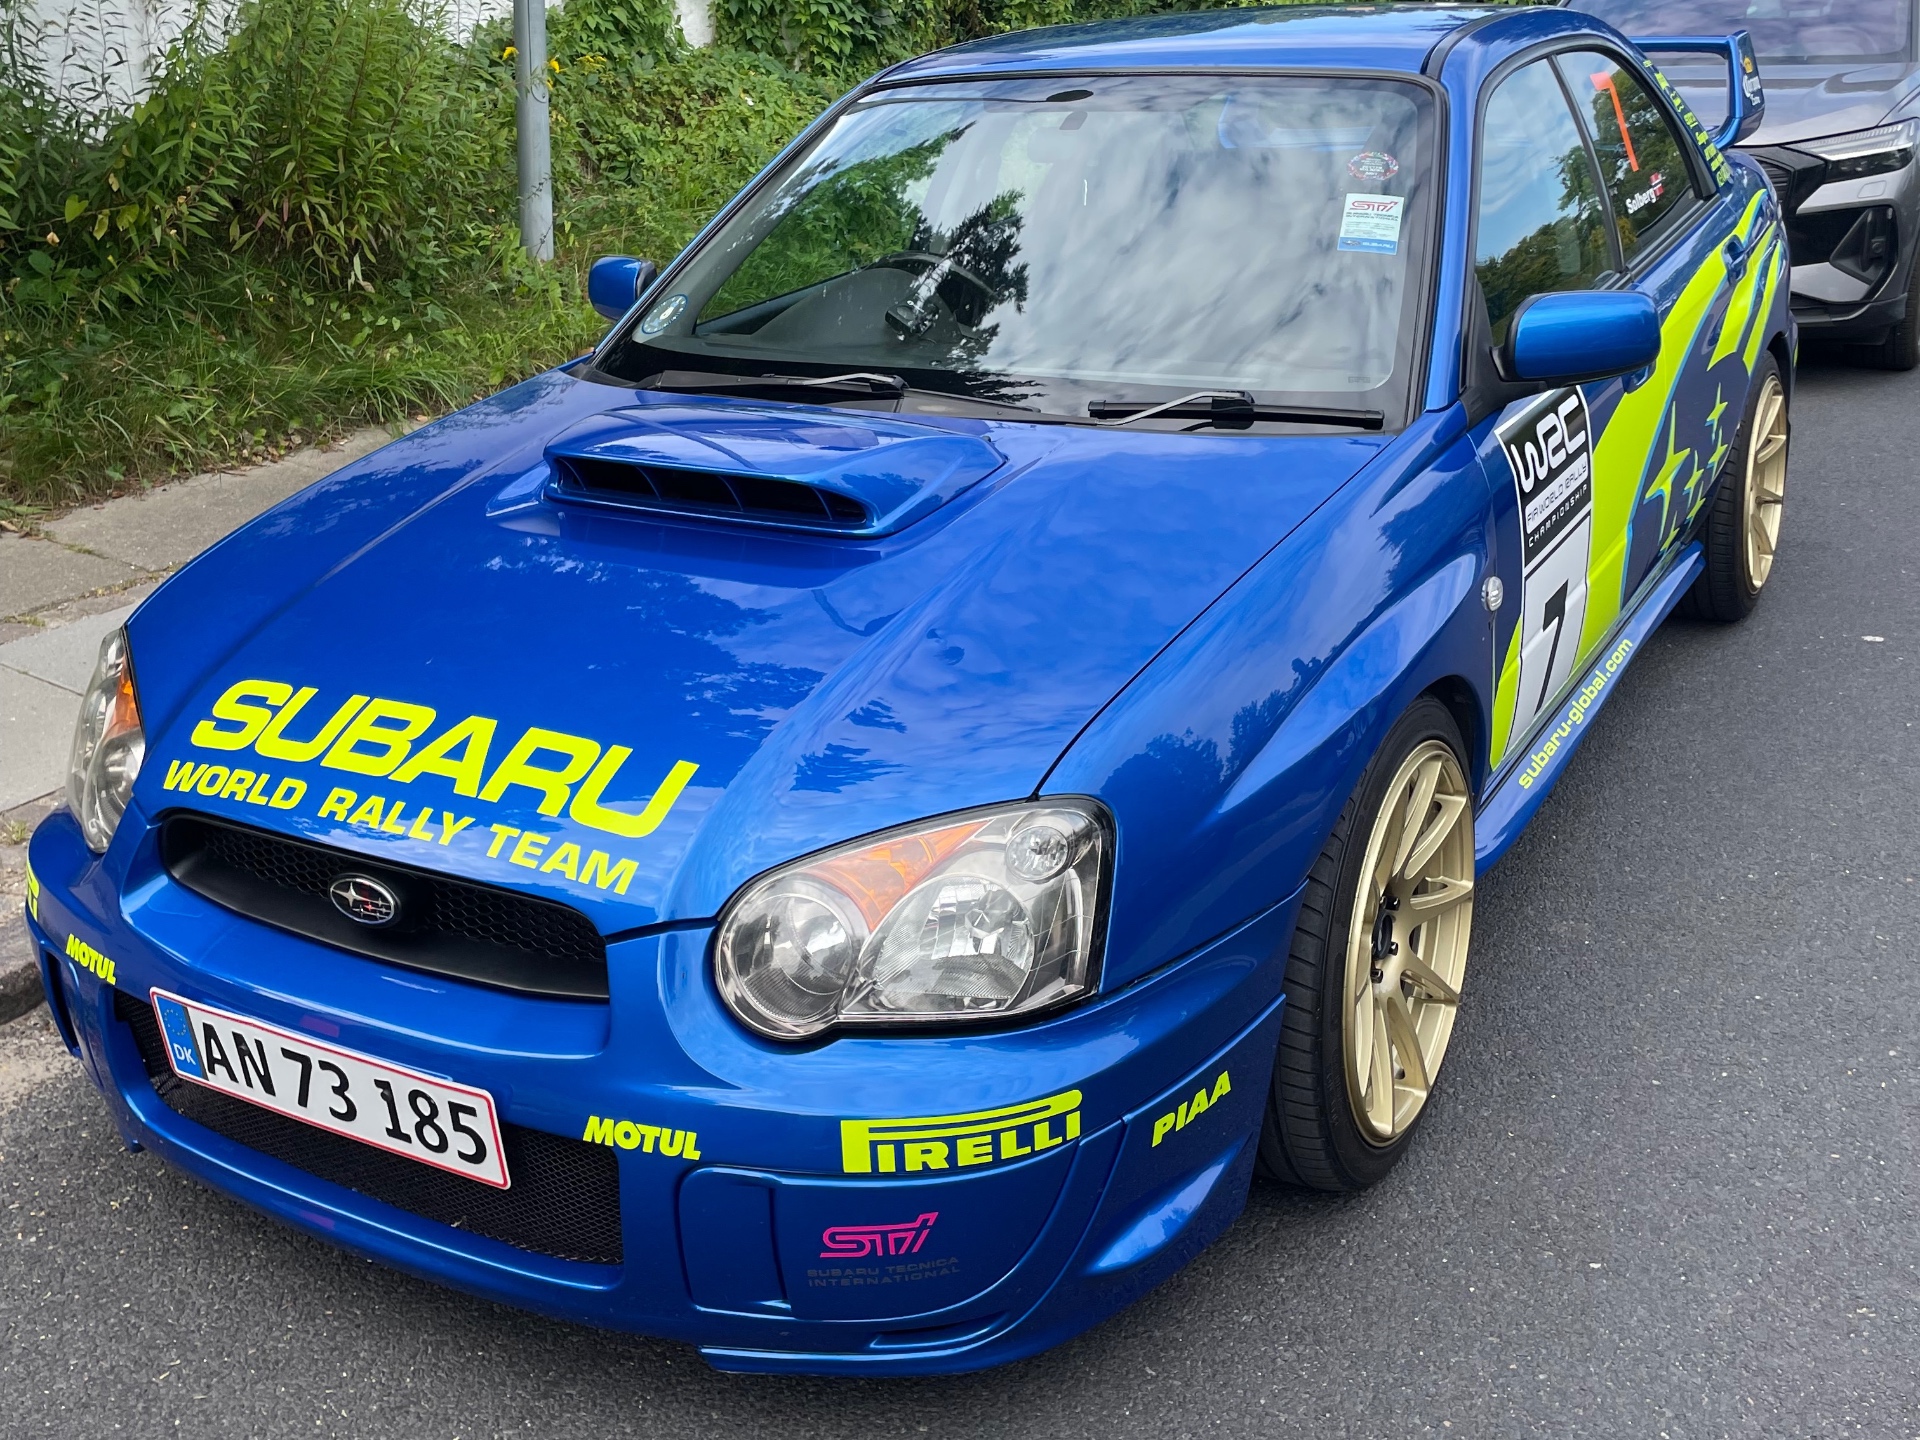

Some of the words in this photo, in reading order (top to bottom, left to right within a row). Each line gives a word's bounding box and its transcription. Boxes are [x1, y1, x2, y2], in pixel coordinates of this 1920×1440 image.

[1626, 188, 1657, 214] Solberg
[1528, 484, 1588, 548] CHAMPIONSHIP
[1533, 578, 1569, 717] 7
[1518, 638, 1634, 790] subaru-global.com
[191, 679, 700, 839] SUBARU
[162, 759, 309, 811] WORLD
[318, 787, 475, 847] RALLY
[485, 823, 640, 896] TEAM
[65, 933, 117, 986] MOTUL
[172, 1042, 197, 1066] DK
[202, 1021, 277, 1098] AN
[281, 1047, 358, 1123] 73
[374, 1079, 488, 1166] 185
[1151, 1071, 1231, 1148] PIAA
[582, 1115, 702, 1161] MOTUL
[840, 1089, 1083, 1174] PIRELLI
[807, 1267, 880, 1278] SUBARU
[885, 1256, 960, 1275] TECNICA
[808, 1266, 961, 1288] INTERNATIONAL
